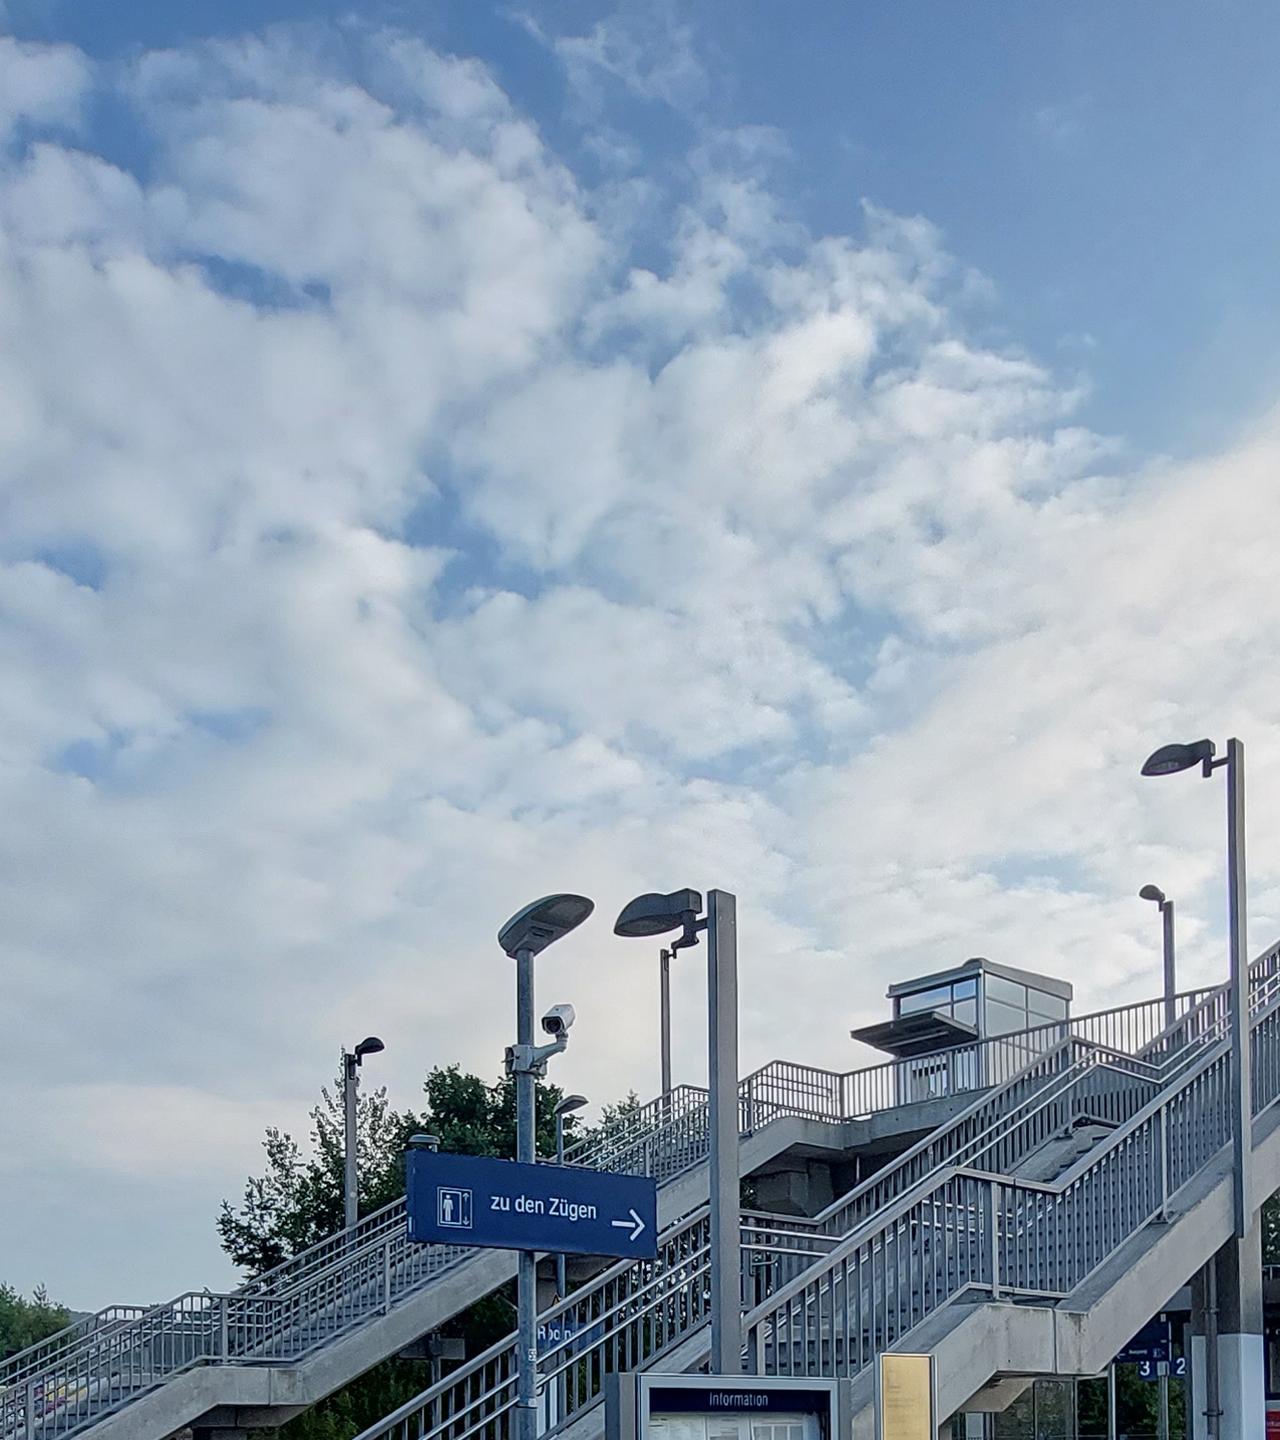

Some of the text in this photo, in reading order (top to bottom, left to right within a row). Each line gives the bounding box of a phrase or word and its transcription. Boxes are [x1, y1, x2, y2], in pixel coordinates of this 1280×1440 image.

[490, 1194, 597, 1222] zu den Zügen
[1139, 1360, 1151, 1377] 3
[1175, 1357, 1186, 1375] 2
[708, 1391, 769, 1407] Information
